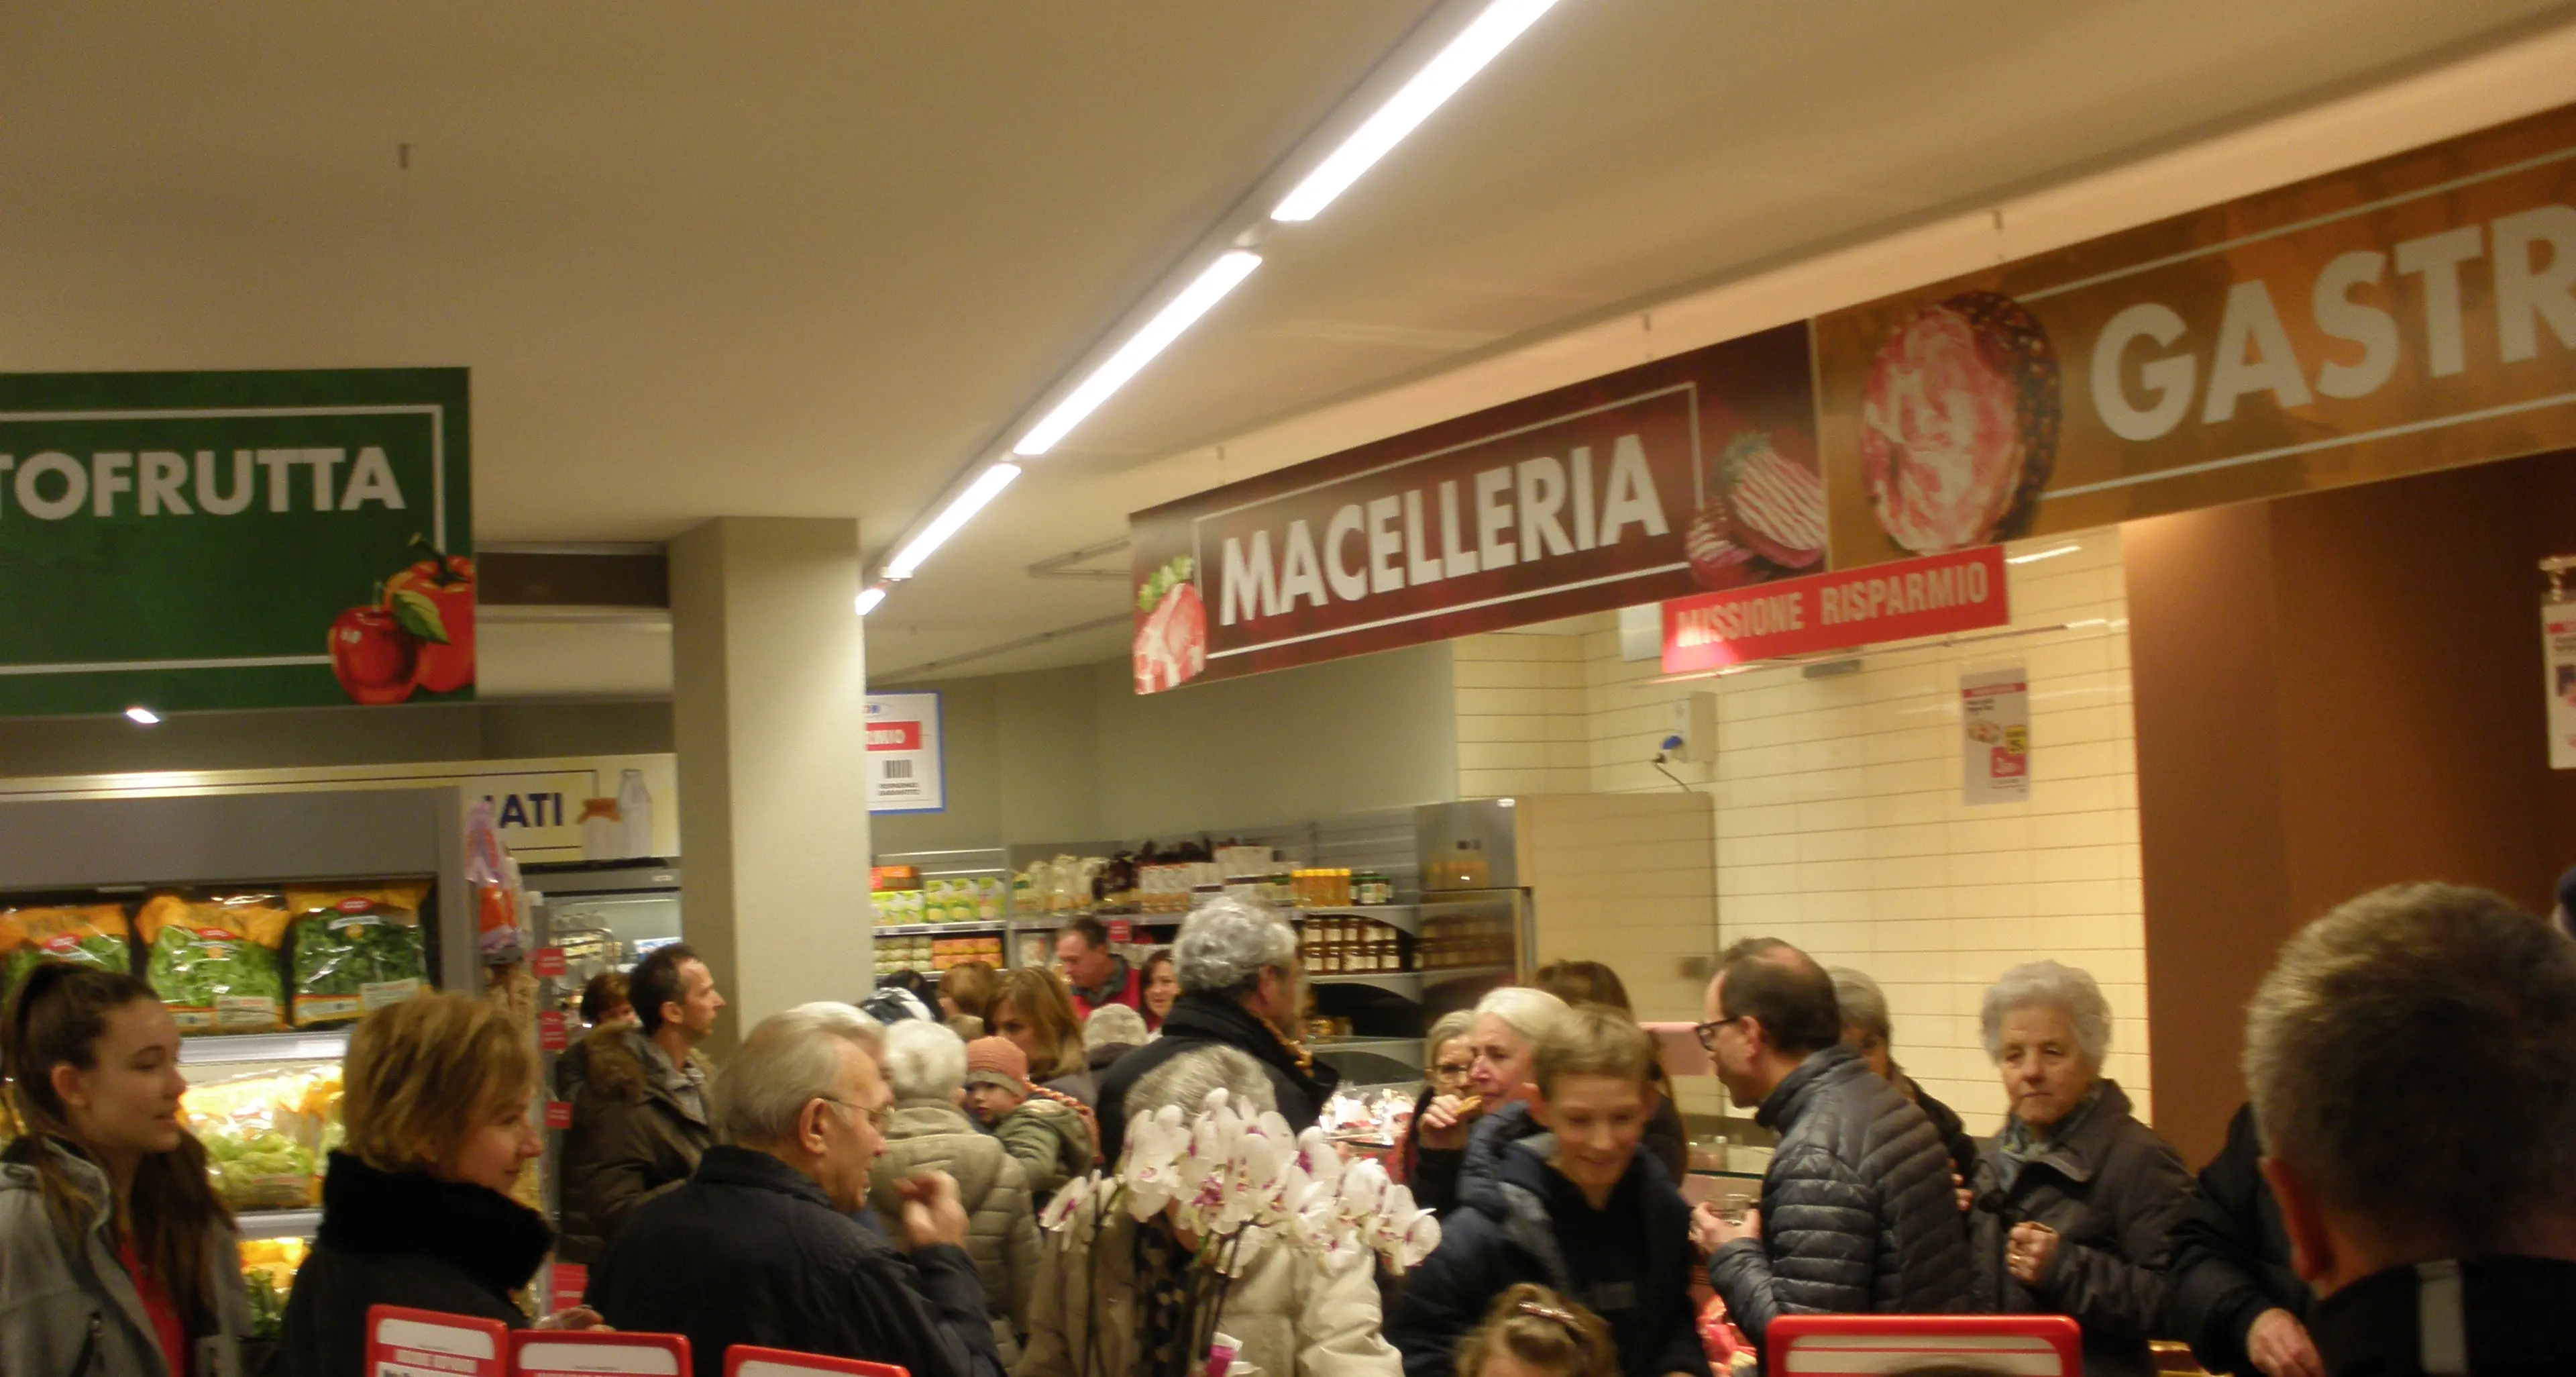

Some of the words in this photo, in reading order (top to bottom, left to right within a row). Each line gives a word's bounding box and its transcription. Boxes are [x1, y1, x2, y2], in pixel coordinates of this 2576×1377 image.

[0, 447, 407, 520] OFRUTTA
[1220, 434, 1670, 626] MACELLERIA
[1678, 593, 1805, 648] MISSIONE
[1819, 561, 1990, 625] RISPARMIO
[484, 793, 562, 828] ATI
